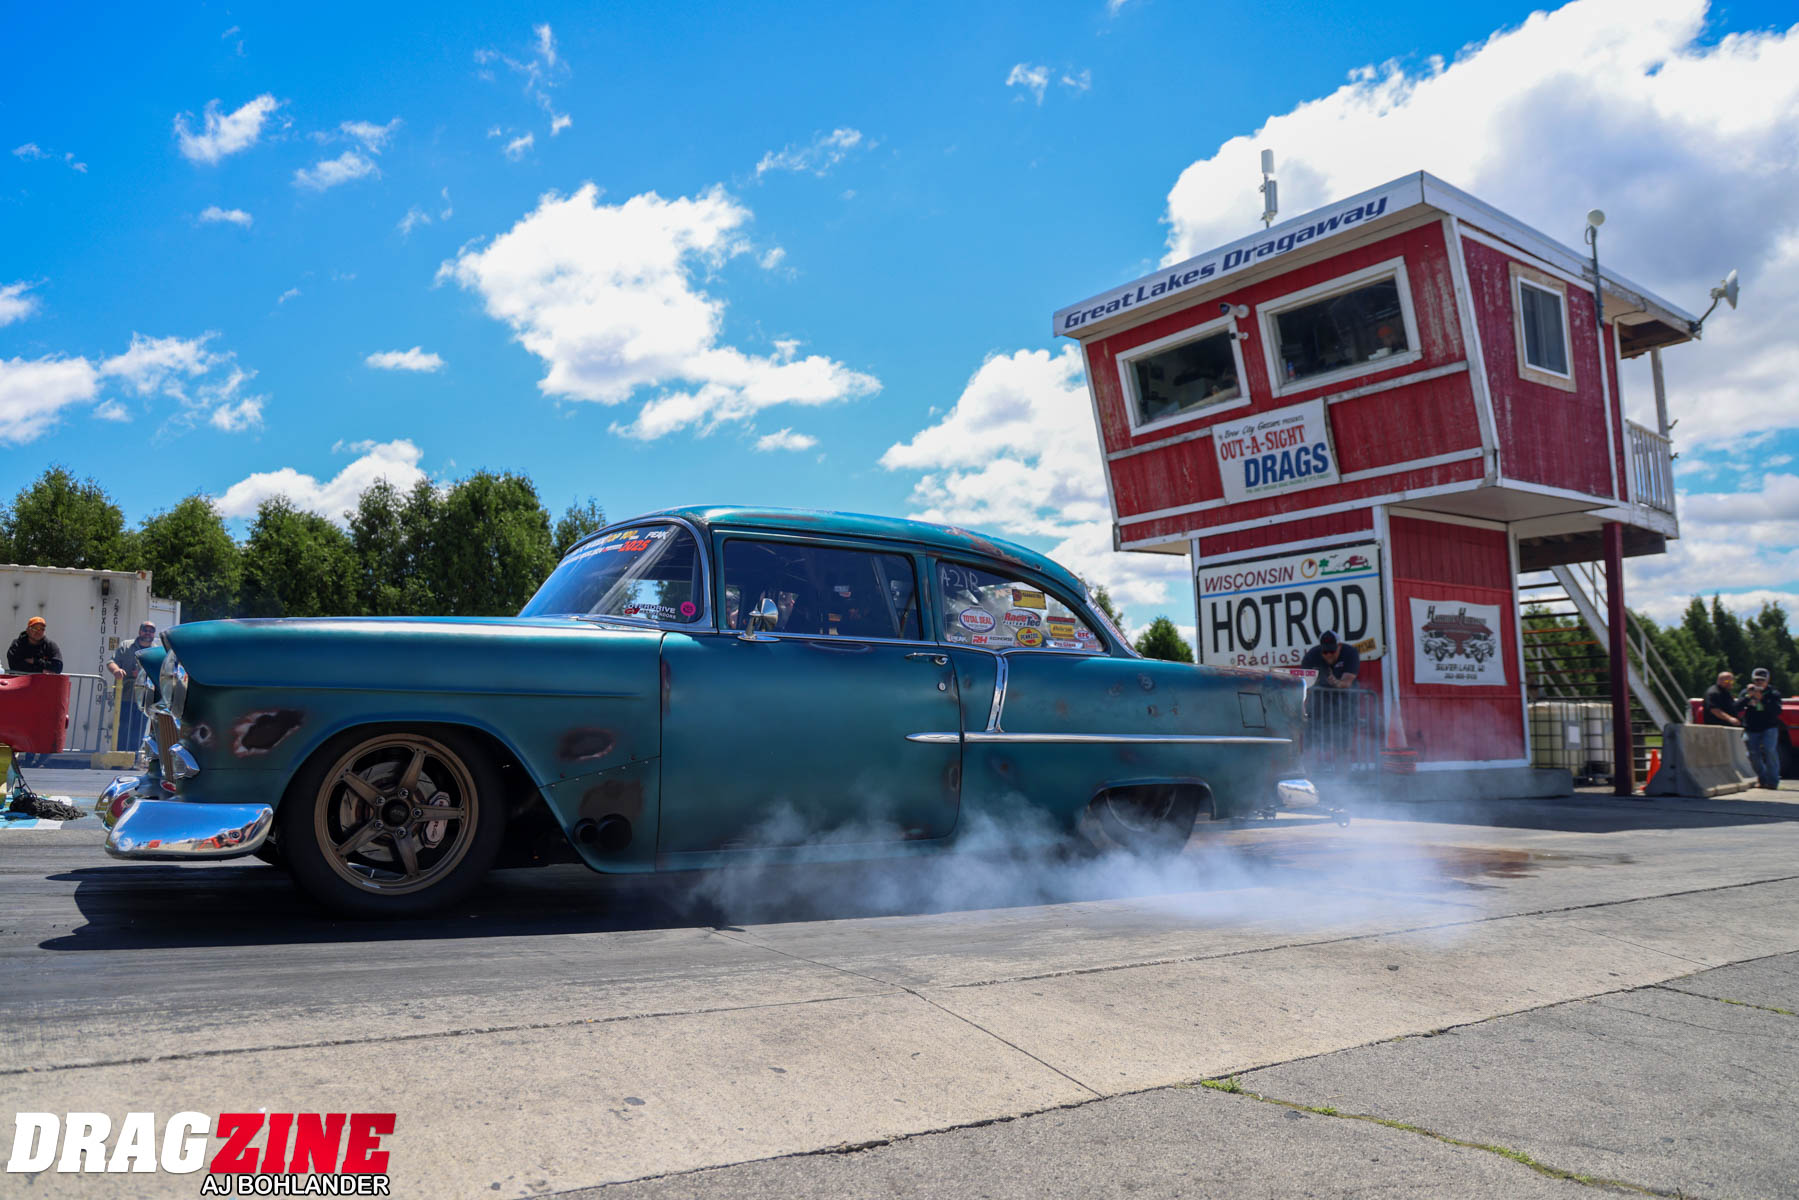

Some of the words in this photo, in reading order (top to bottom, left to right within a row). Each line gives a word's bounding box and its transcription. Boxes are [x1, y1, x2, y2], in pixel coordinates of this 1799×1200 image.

[1064, 293, 1134, 329] Great
[1136, 263, 1215, 301] Lakes
[1222, 196, 1388, 273] Dragaway
[1220, 424, 1305, 461] OUT-A-SIGHT
[1242, 425, 1255, 436] City
[1244, 442, 1329, 489] DRAGS
[617, 539, 652, 552] 2025
[1204, 565, 1294, 593] WISCONSIN
[628, 603, 676, 614] OVERDRIVE
[962, 614, 978, 624] TOTAL
[978, 615, 993, 625] SEAL
[1211, 584, 1368, 653] HOTROD
